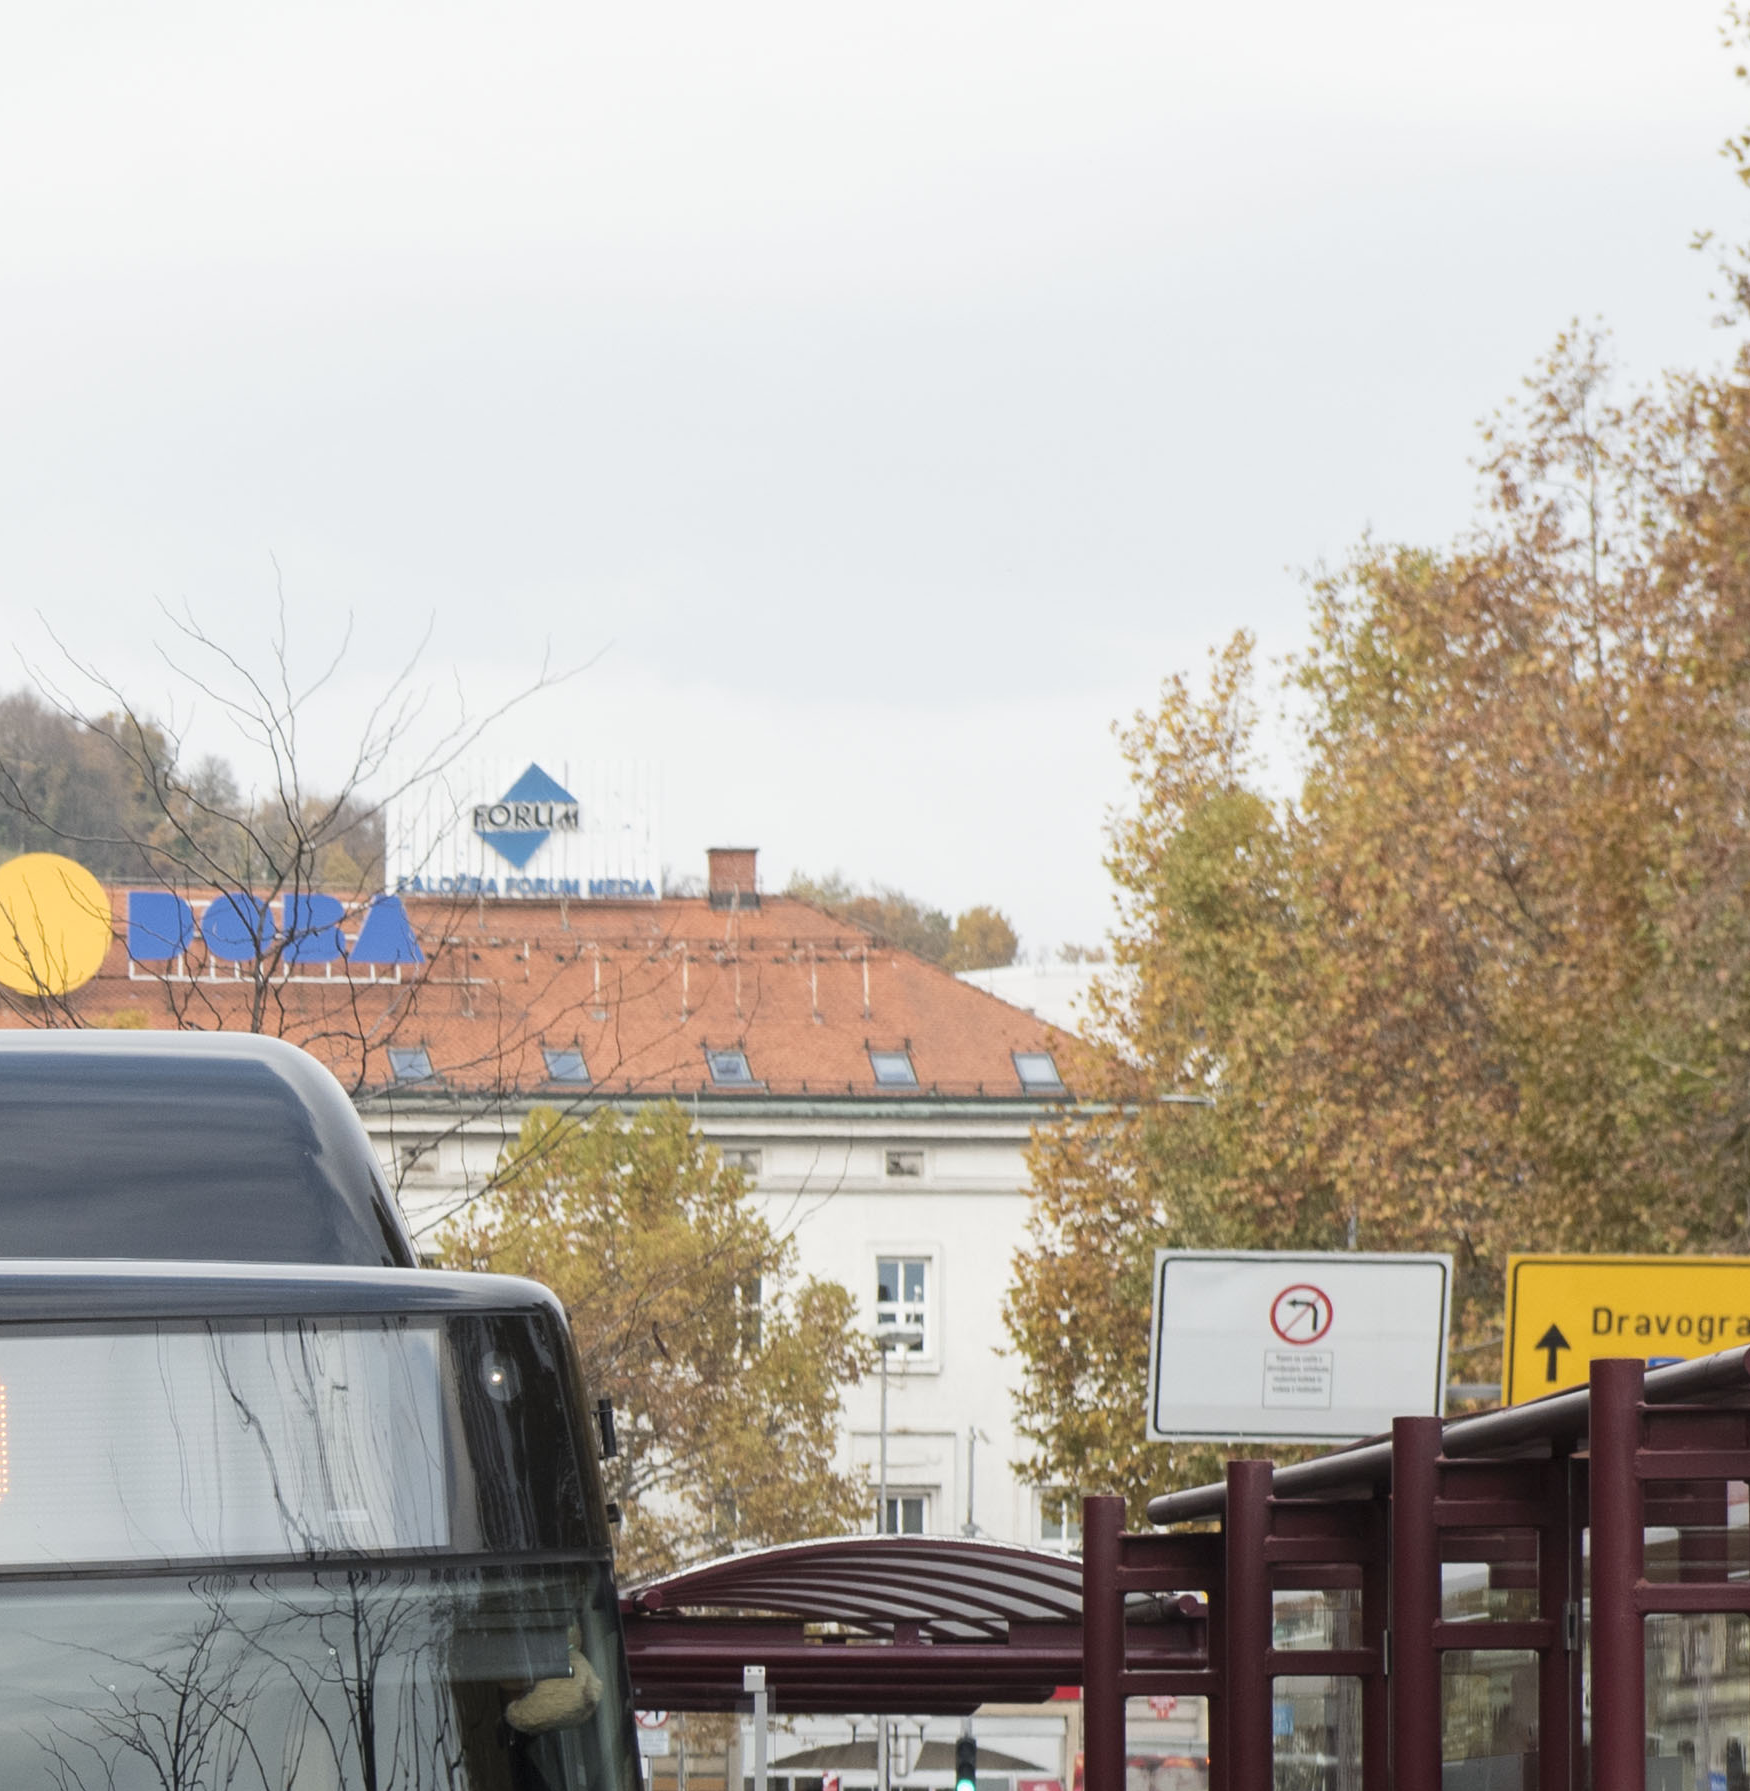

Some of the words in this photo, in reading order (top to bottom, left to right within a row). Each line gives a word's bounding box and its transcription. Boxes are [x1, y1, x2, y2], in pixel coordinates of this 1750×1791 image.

[473, 803, 579, 831] FORUM
[505, 878, 580, 895] FORUM
[588, 880, 656, 896] MEDIA
